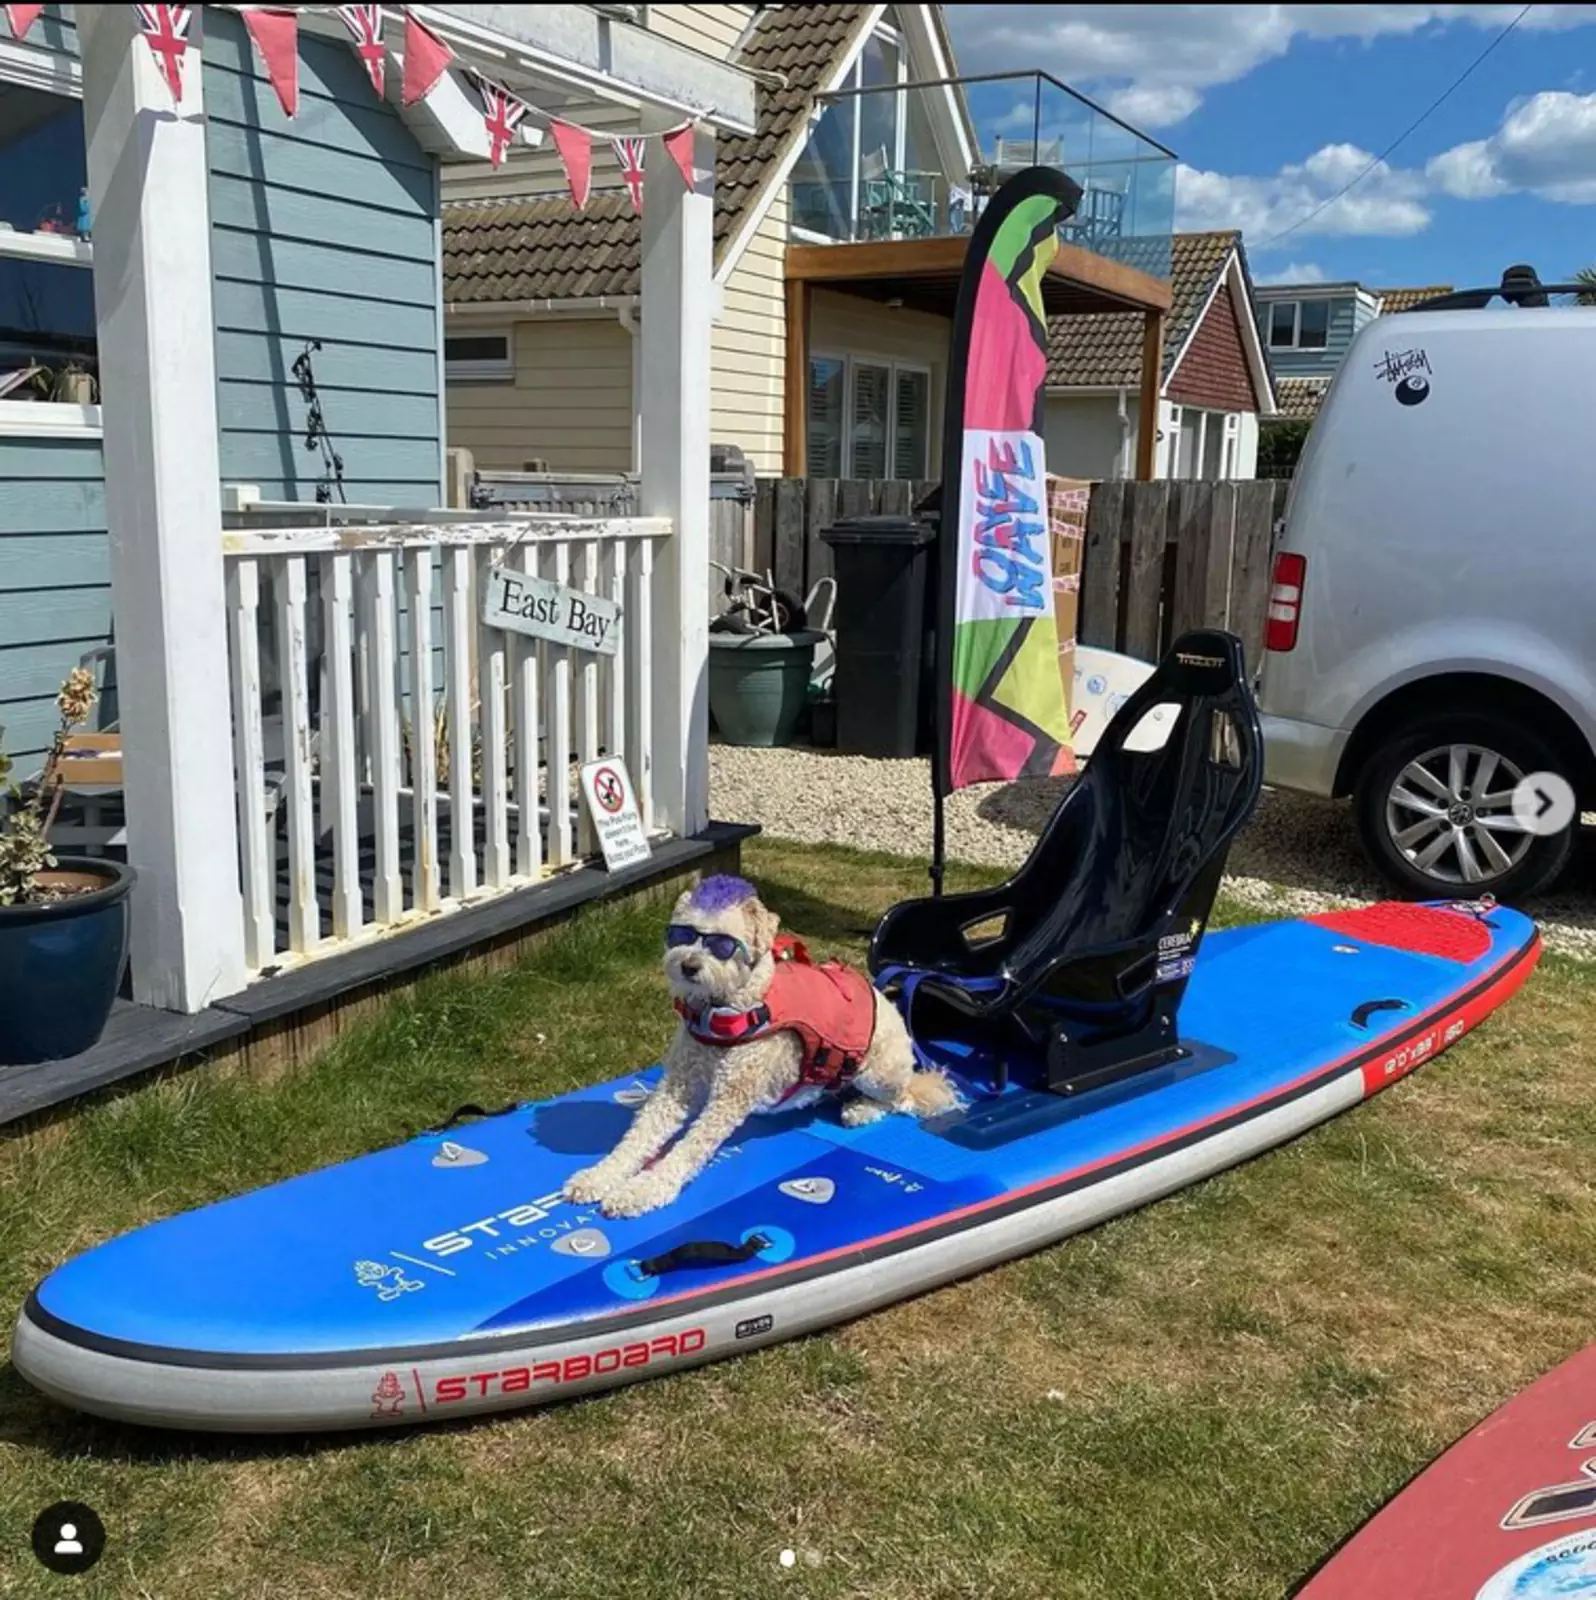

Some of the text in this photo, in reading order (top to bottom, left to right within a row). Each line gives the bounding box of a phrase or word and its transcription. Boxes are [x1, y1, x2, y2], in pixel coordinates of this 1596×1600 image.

[973, 457, 1018, 594] ONE
[988, 436, 1045, 611] WAVE
[499, 577, 610, 648] East Bay
[435, 1327, 706, 1404] STARBOARD
